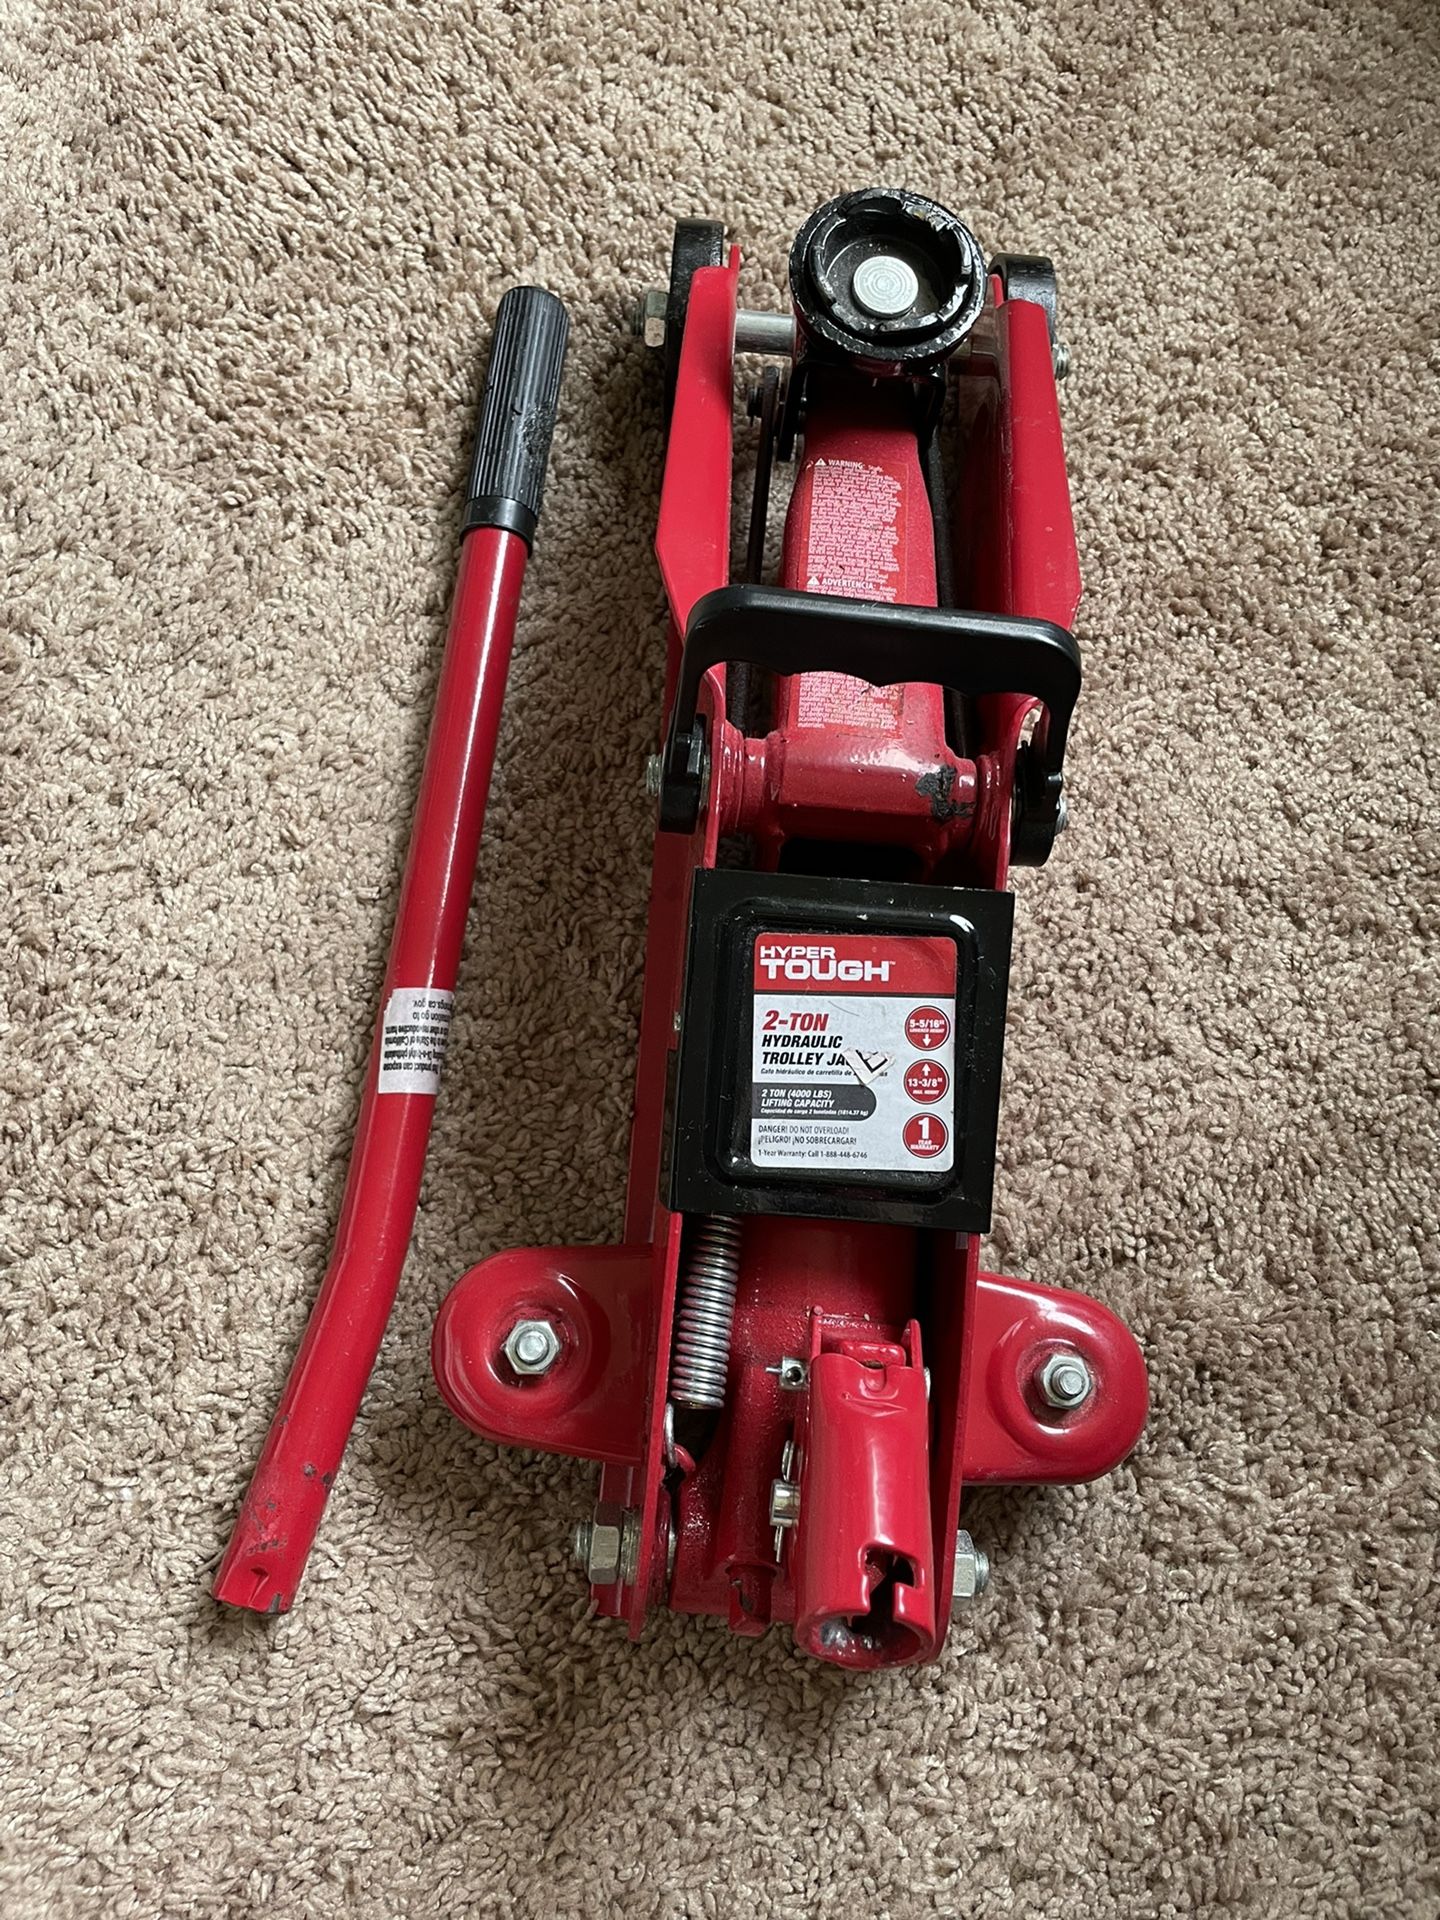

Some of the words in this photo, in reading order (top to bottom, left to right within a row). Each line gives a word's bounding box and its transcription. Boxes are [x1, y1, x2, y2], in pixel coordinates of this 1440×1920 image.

[760, 946, 836, 959] HYPER
[760, 958, 890, 982] TOUGH
[413, 1012, 420, 1021] to
[421, 1010, 430, 1020] go
[762, 1010, 829, 1031] 2-TON
[385, 1036, 409, 1046] California
[409, 1036, 415, 1046] of
[762, 1034, 843, 1048] HYDRAULIC
[762, 1052, 824, 1066] TROLLEY
[826, 1053, 852, 1067] JA
[383, 1060, 402, 1071] expose
[761, 1089, 768, 1097] 2
[770, 1089, 786, 1097] TON
[788, 1089, 812, 1099] (4000
[813, 1090, 832, 1100] LBS)
[761, 1098, 792, 1107] LIFTING
[794, 1099, 834, 1108] CAPACITY
[758, 1125, 788, 1133] DANGER!
[814, 1126, 849, 1134] OVERLOAD!
[918, 1117, 930, 1140] 1
[806, 1136, 857, 1145] SOBRECARGAR!
